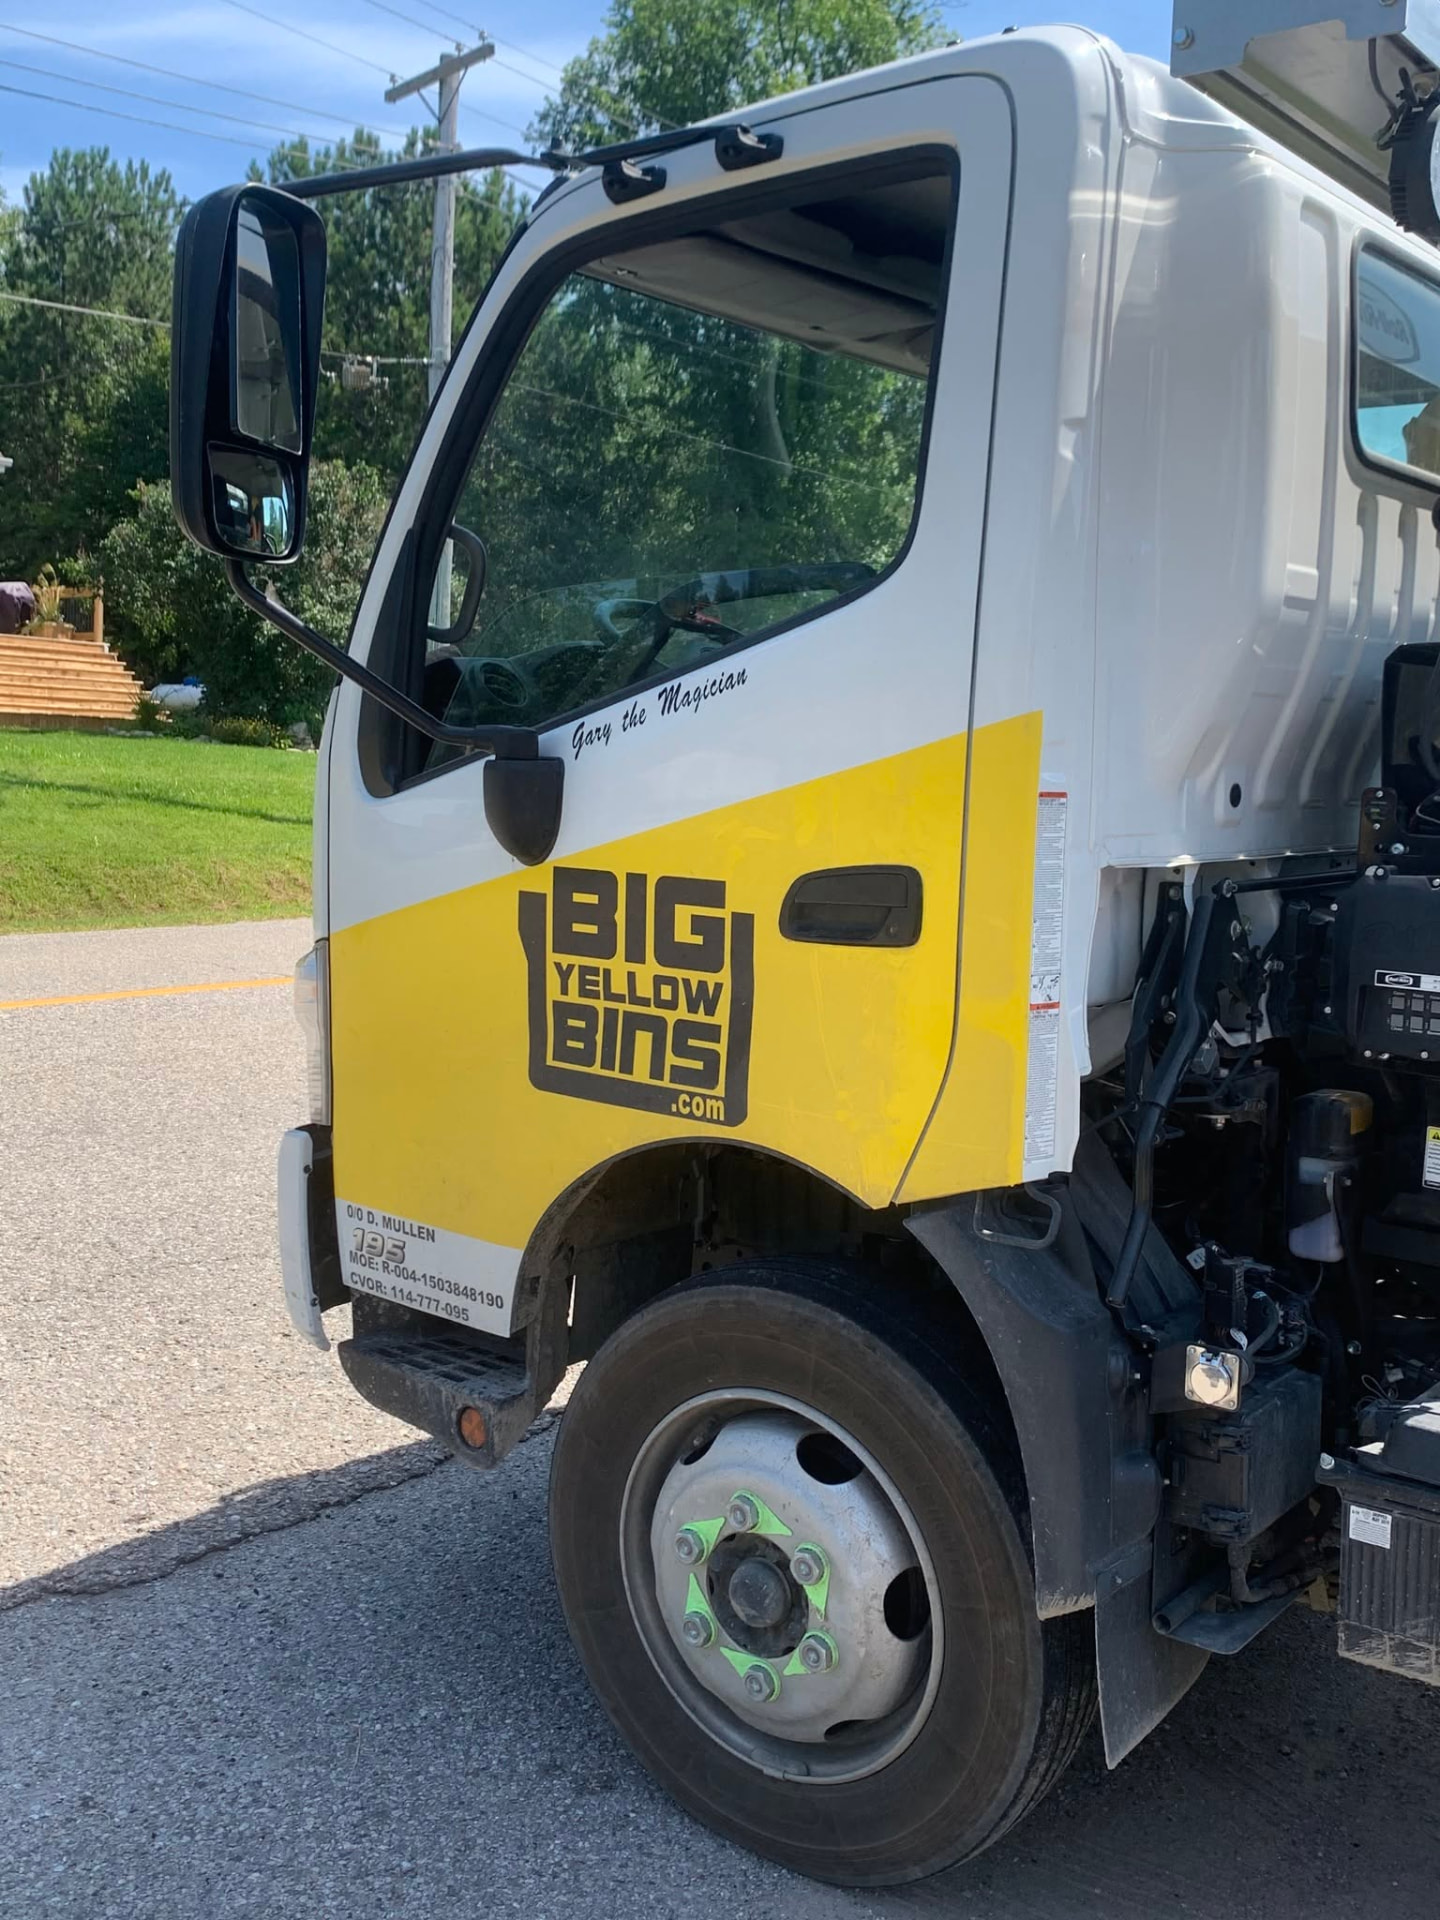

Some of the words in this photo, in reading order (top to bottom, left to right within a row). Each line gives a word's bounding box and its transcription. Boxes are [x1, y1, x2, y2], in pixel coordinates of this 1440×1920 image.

[571, 721, 612, 760] Gary
[622, 701, 647, 732] the
[658, 668, 748, 716] Magician
[552, 865, 726, 974] BIG
[553, 961, 724, 1017] YELLOW
[671, 1093, 725, 1121] .com
[353, 1227, 406, 1265] 195
[367, 1210, 378, 1227] D.
[382, 1215, 436, 1243] MULLEN
[349, 1250, 380, 1271] MOE:
[382, 1260, 504, 1309] R-004-1503848190
[350, 1272, 387, 1296] CVOR:
[391, 1286, 470, 1322] 114-777-095
